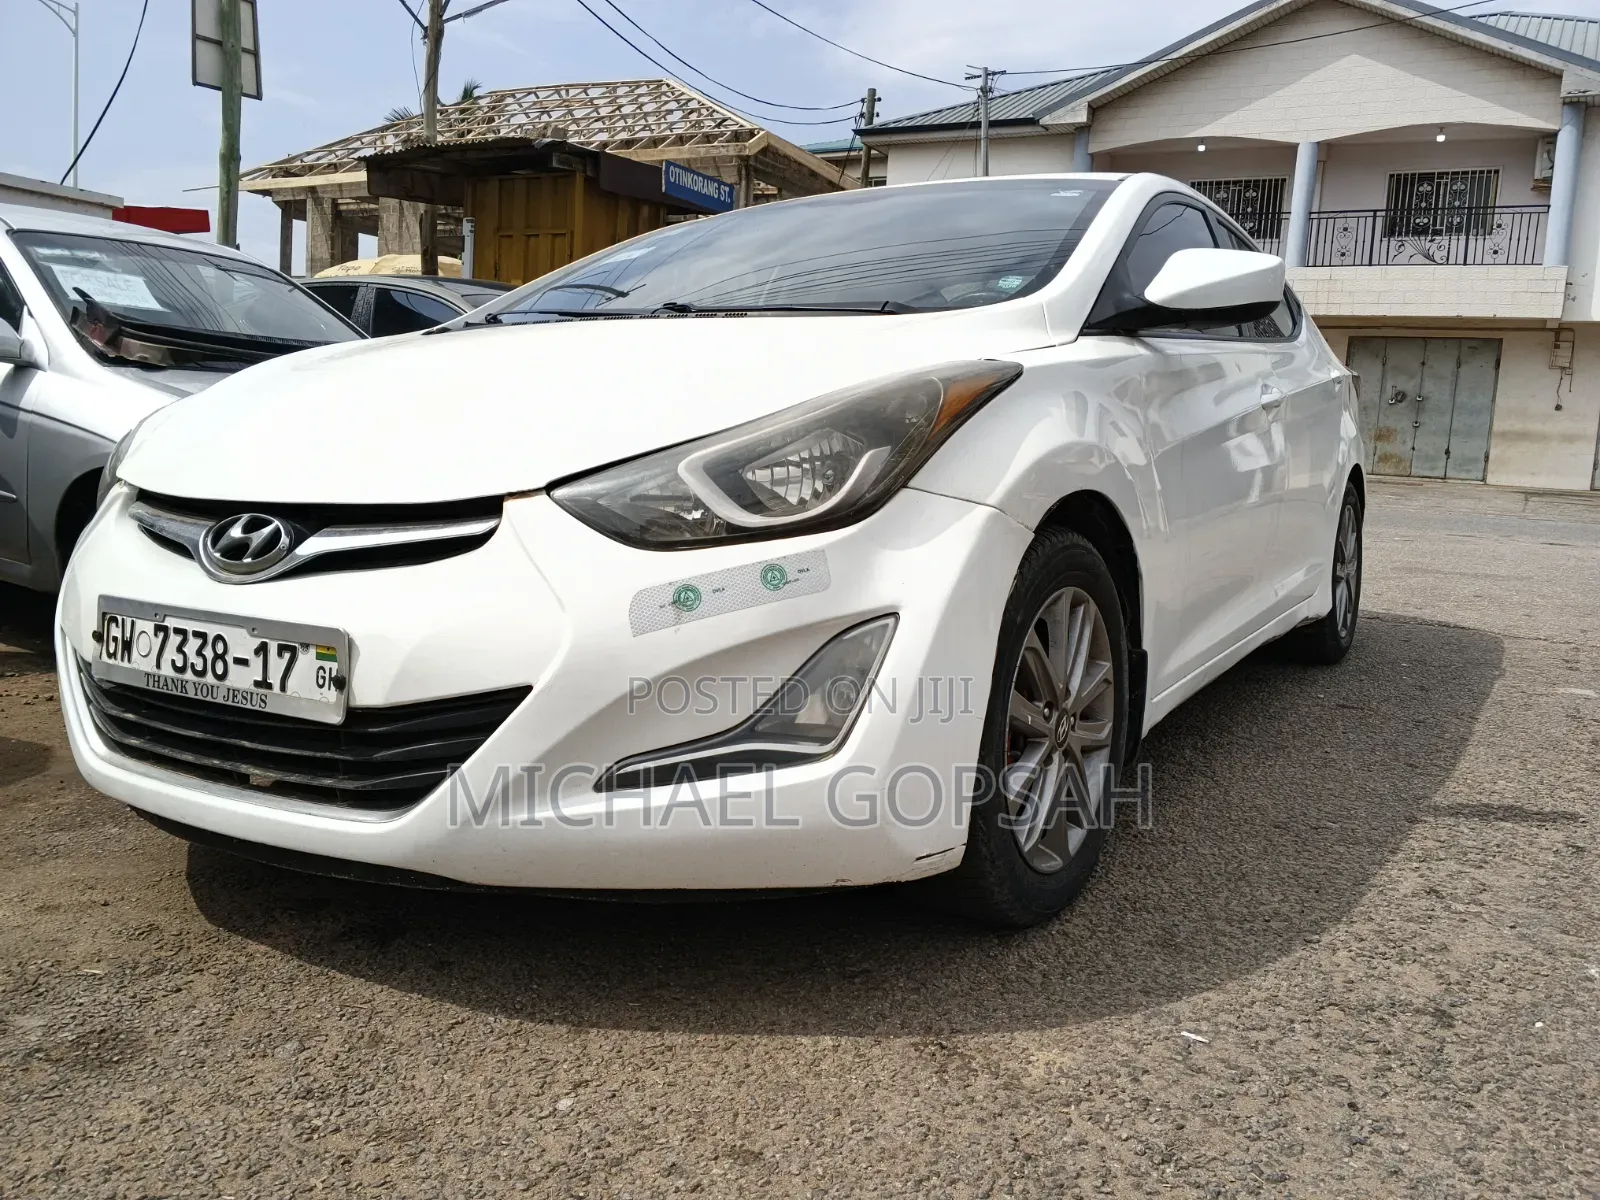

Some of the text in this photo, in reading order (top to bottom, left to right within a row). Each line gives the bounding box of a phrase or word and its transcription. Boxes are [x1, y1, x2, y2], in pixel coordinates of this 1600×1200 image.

[669, 165, 731, 203] OTINKORANG ST.
[105, 615, 299, 693] GW 7338-17
[143, 672, 268, 709] THANK YOU JESUS
